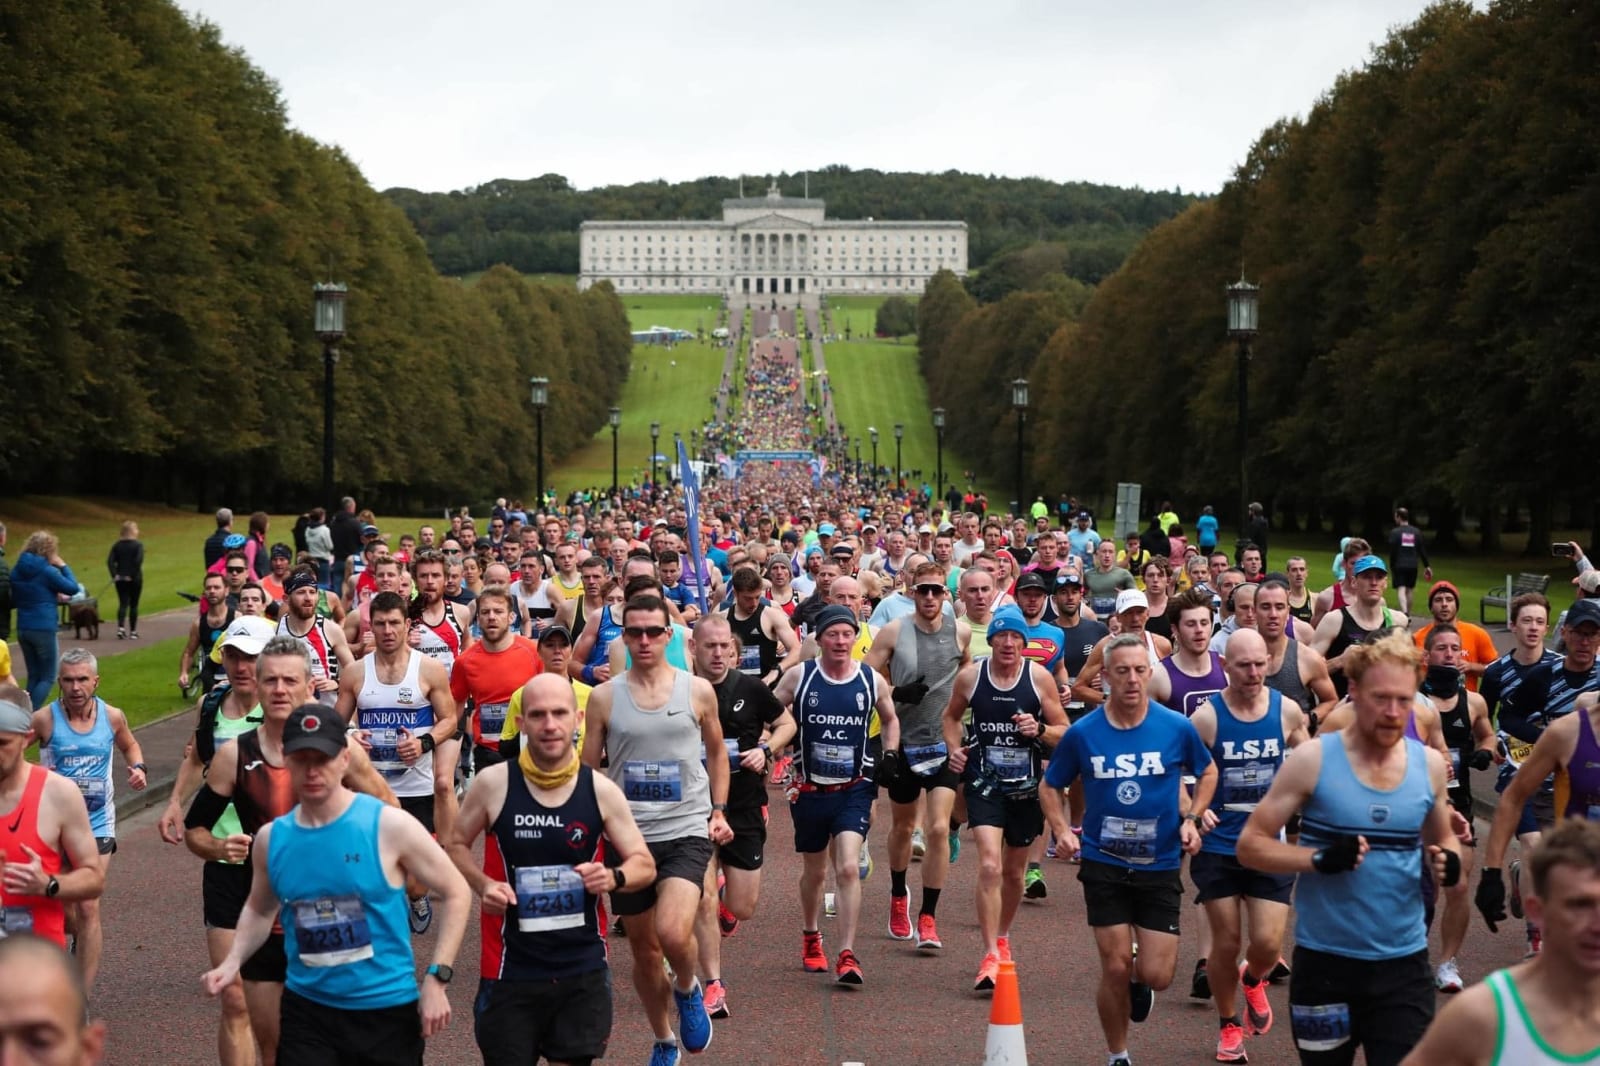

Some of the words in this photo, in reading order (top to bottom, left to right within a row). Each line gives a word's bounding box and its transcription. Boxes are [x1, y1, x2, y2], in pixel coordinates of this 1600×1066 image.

[362, 712, 417, 725] DUNBOYNE
[808, 714, 863, 726] CORRAN
[980, 722, 1020, 732] CORRA
[822, 730, 848, 740] A.C.
[994, 736, 1018, 746] A.C.
[1222, 739, 1280, 760] LSA
[1090, 751, 1165, 779] LSA
[631, 784, 673, 799] 4485
[514, 814, 564, 828] DONAL
[526, 893, 575, 914] 4243
[302, 924, 355, 948] 2231
